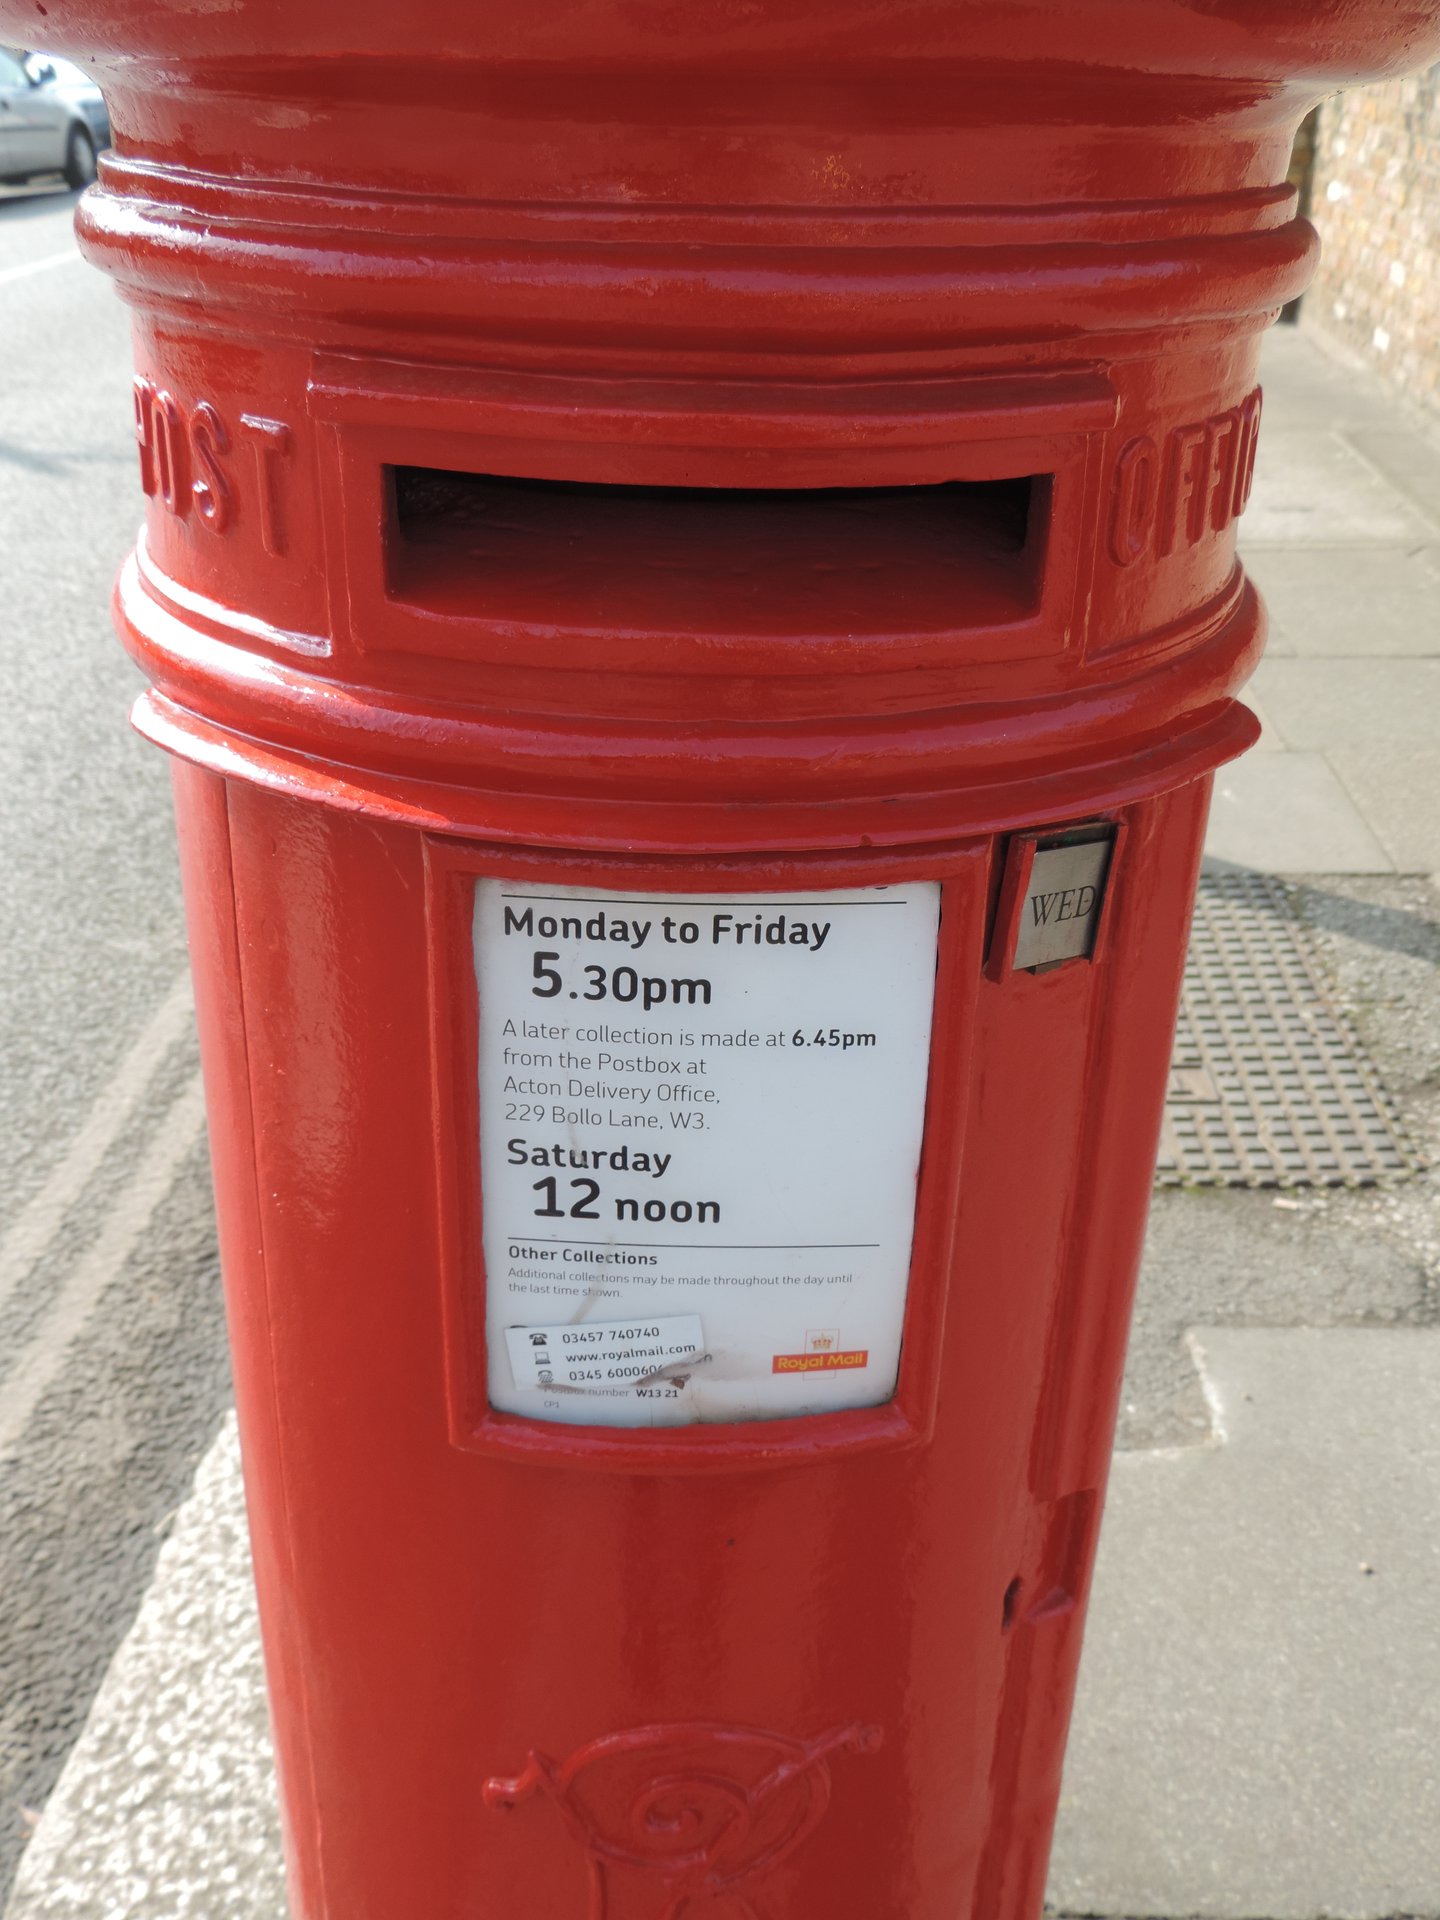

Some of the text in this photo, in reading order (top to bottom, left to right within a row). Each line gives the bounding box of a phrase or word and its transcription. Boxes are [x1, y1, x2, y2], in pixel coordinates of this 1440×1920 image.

[1031, 885, 1096, 927] WED
[504, 906, 831, 951] Monday to Friday
[532, 951, 712, 1011] 5.30pm
[502, 1019, 876, 1050] A later collection is made at 6.45pm
[503, 1047, 707, 1074] from the Postbox at
[504, 1076, 721, 1104] Acton Delivery Office,
[505, 1103, 711, 1130] 229 Bollo Lane, W3.
[507, 1138, 672, 1178] Saturday
[532, 1175, 721, 1223] 12 noon
[509, 1245, 658, 1266] Other Collections
[508, 1267, 853, 1288] Additional collections may be made throughout the day until
[509, 1282, 624, 1299] the last time shown.
[562, 1327, 660, 1344] 03457 740740
[566, 1343, 696, 1363] www.royalmail.com
[778, 1353, 863, 1371] Royal Mail
[569, 1370, 602, 1381] 0345
[588, 1388, 630, 1398] number
[636, 1388, 662, 1398] W13
[664, 1388, 679, 1398] 21
